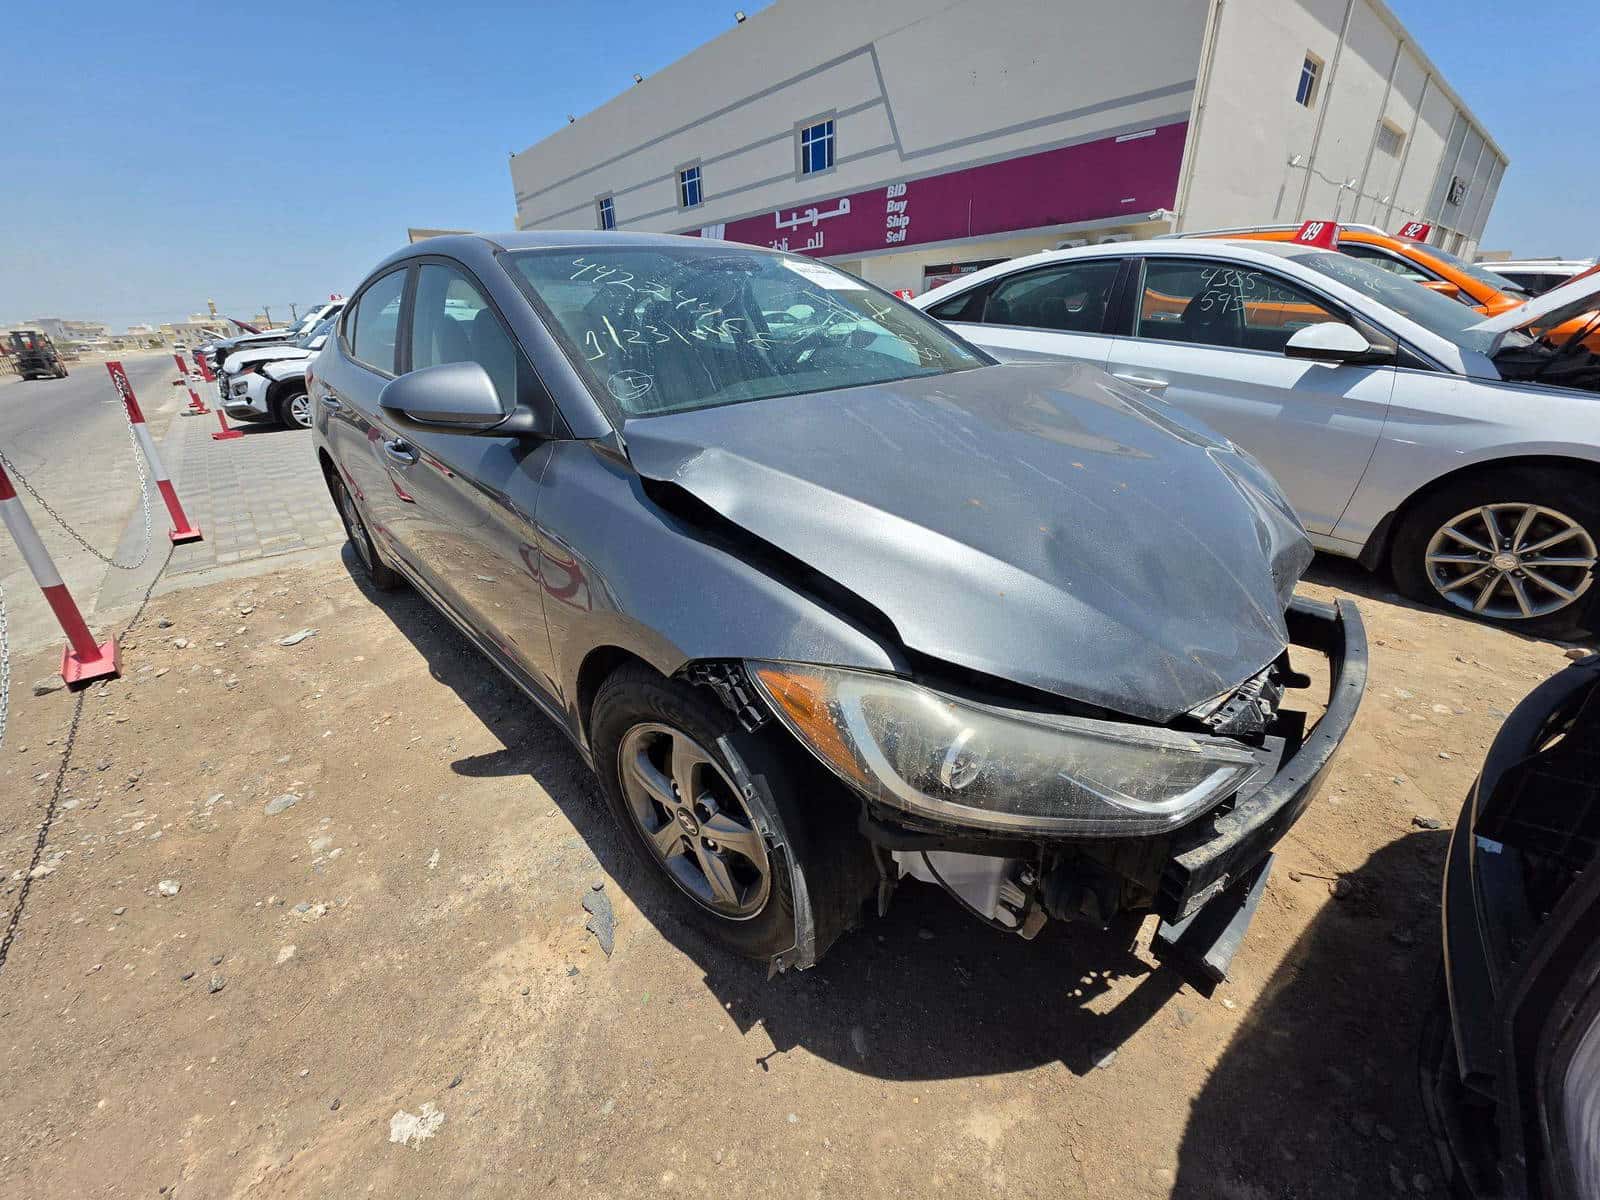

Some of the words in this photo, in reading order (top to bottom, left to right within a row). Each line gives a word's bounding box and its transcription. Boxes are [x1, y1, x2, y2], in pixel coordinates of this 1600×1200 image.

[886, 183, 907, 198] BID
[886, 200, 908, 213] Buy
[775, 198, 851, 232] مرحبا
[886, 214, 910, 229] Ship
[886, 229, 907, 243] Sell
[1301, 222, 1324, 240] 89
[1404, 223, 1423, 237] 92
